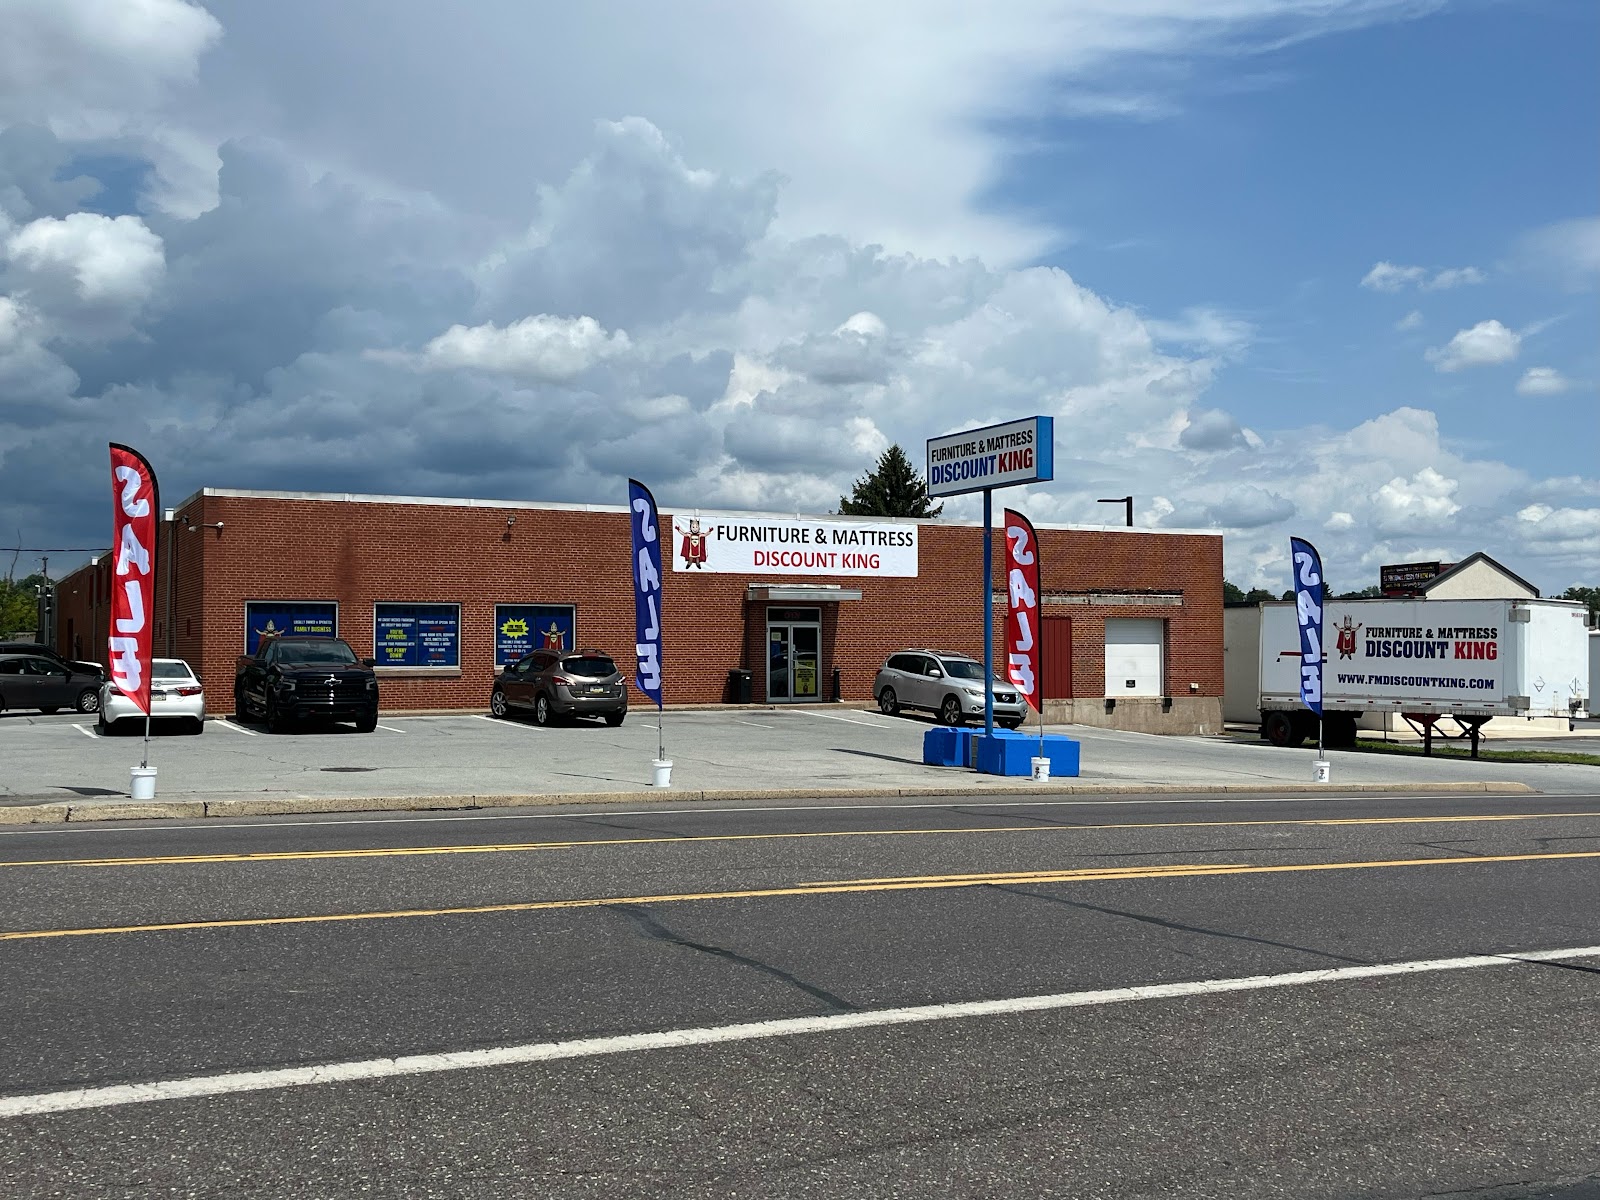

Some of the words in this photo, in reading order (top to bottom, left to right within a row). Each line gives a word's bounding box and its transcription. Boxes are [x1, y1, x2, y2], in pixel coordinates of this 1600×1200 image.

[932, 441, 976, 463] FURNITURE
[979, 440, 985, 453] &
[987, 429, 1033, 452] MATTRESS
[932, 455, 997, 485] DISCOUNT
[998, 447, 1033, 474] KING
[717, 525, 810, 544] FURNITURE
[815, 528, 828, 545] &
[833, 529, 914, 547] MATTRESS
[754, 550, 837, 568] DISCOUNT
[842, 553, 880, 569] KING
[1366, 627, 1422, 639] FURNITURE
[1426, 629, 1434, 639] &
[1438, 627, 1498, 640] MATTRESS
[1366, 641, 1449, 660] DISCOUNT
[1454, 641, 1498, 660] KING
[1337, 673, 1495, 690] WWW.FMDISCOUNTKING.COM
